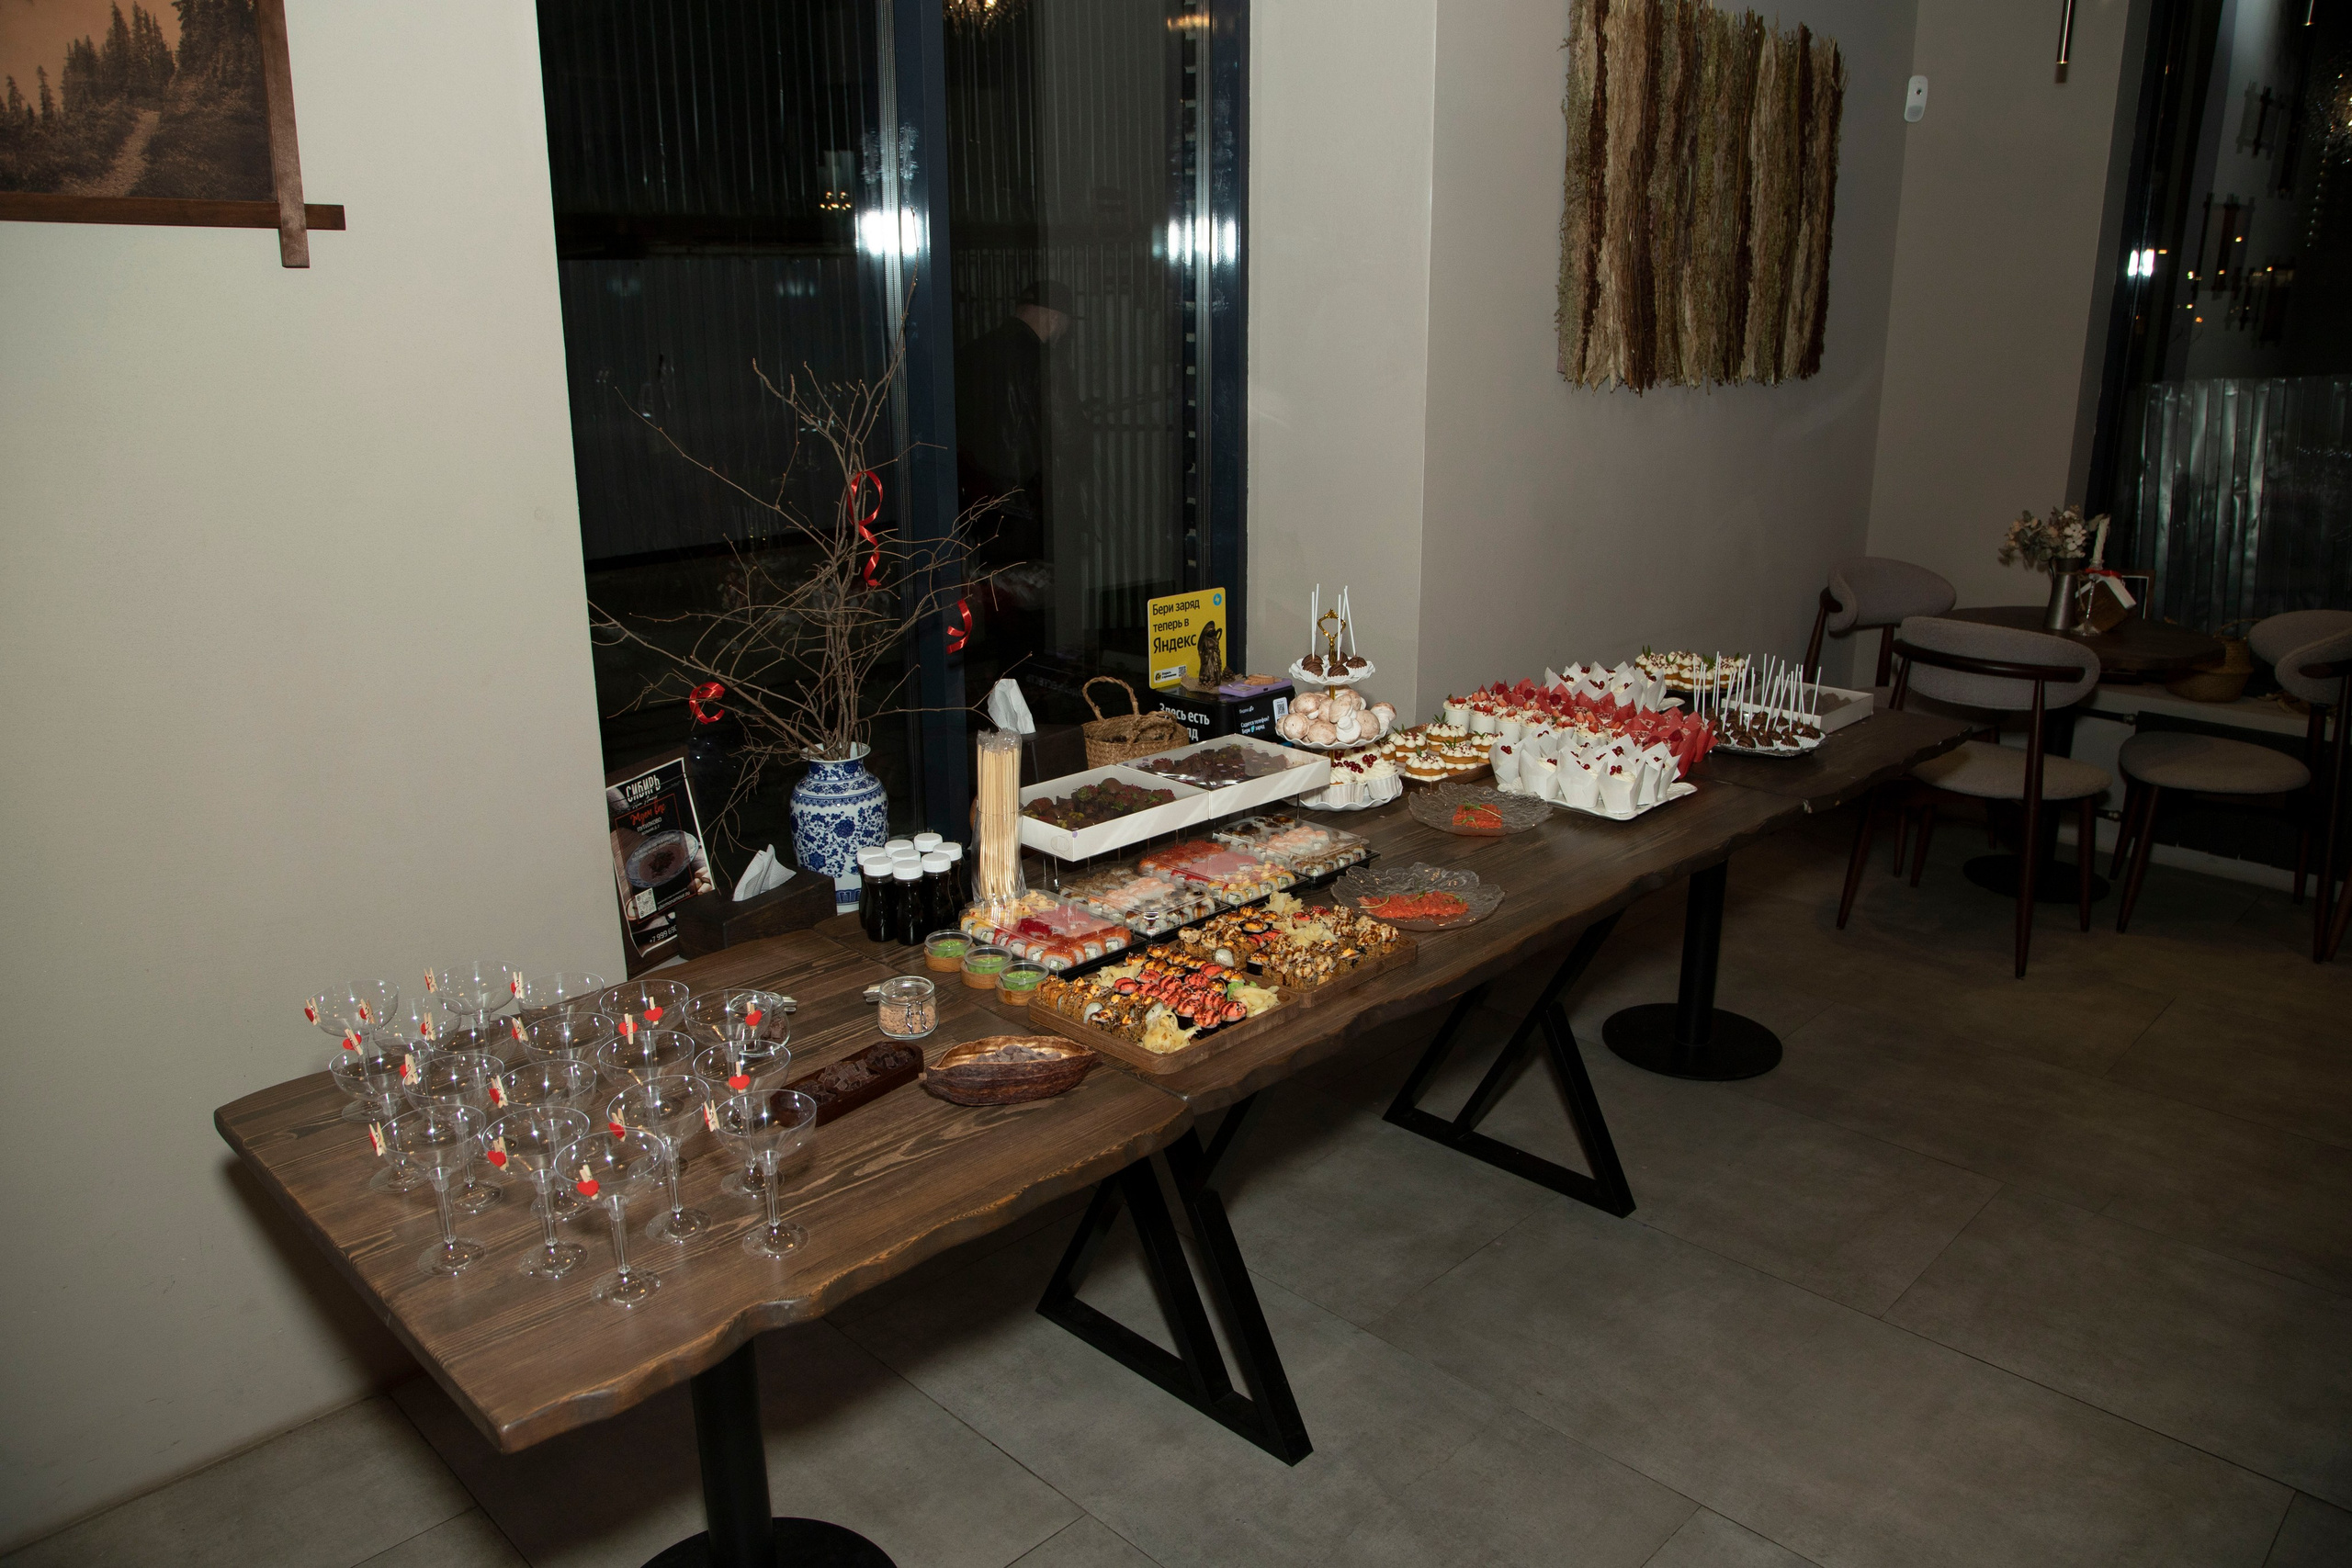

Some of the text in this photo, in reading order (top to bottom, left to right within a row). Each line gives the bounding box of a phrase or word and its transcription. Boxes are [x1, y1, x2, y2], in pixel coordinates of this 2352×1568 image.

[1152, 599, 1200, 615] Бери заряд
[1153, 618, 1190, 633] теперь в
[1153, 634, 1197, 654] Яндекс
[1187, 711, 1210, 726] есть
[626, 773, 662, 803] СИБИРЬ
[656, 930, 668, 941] 999
